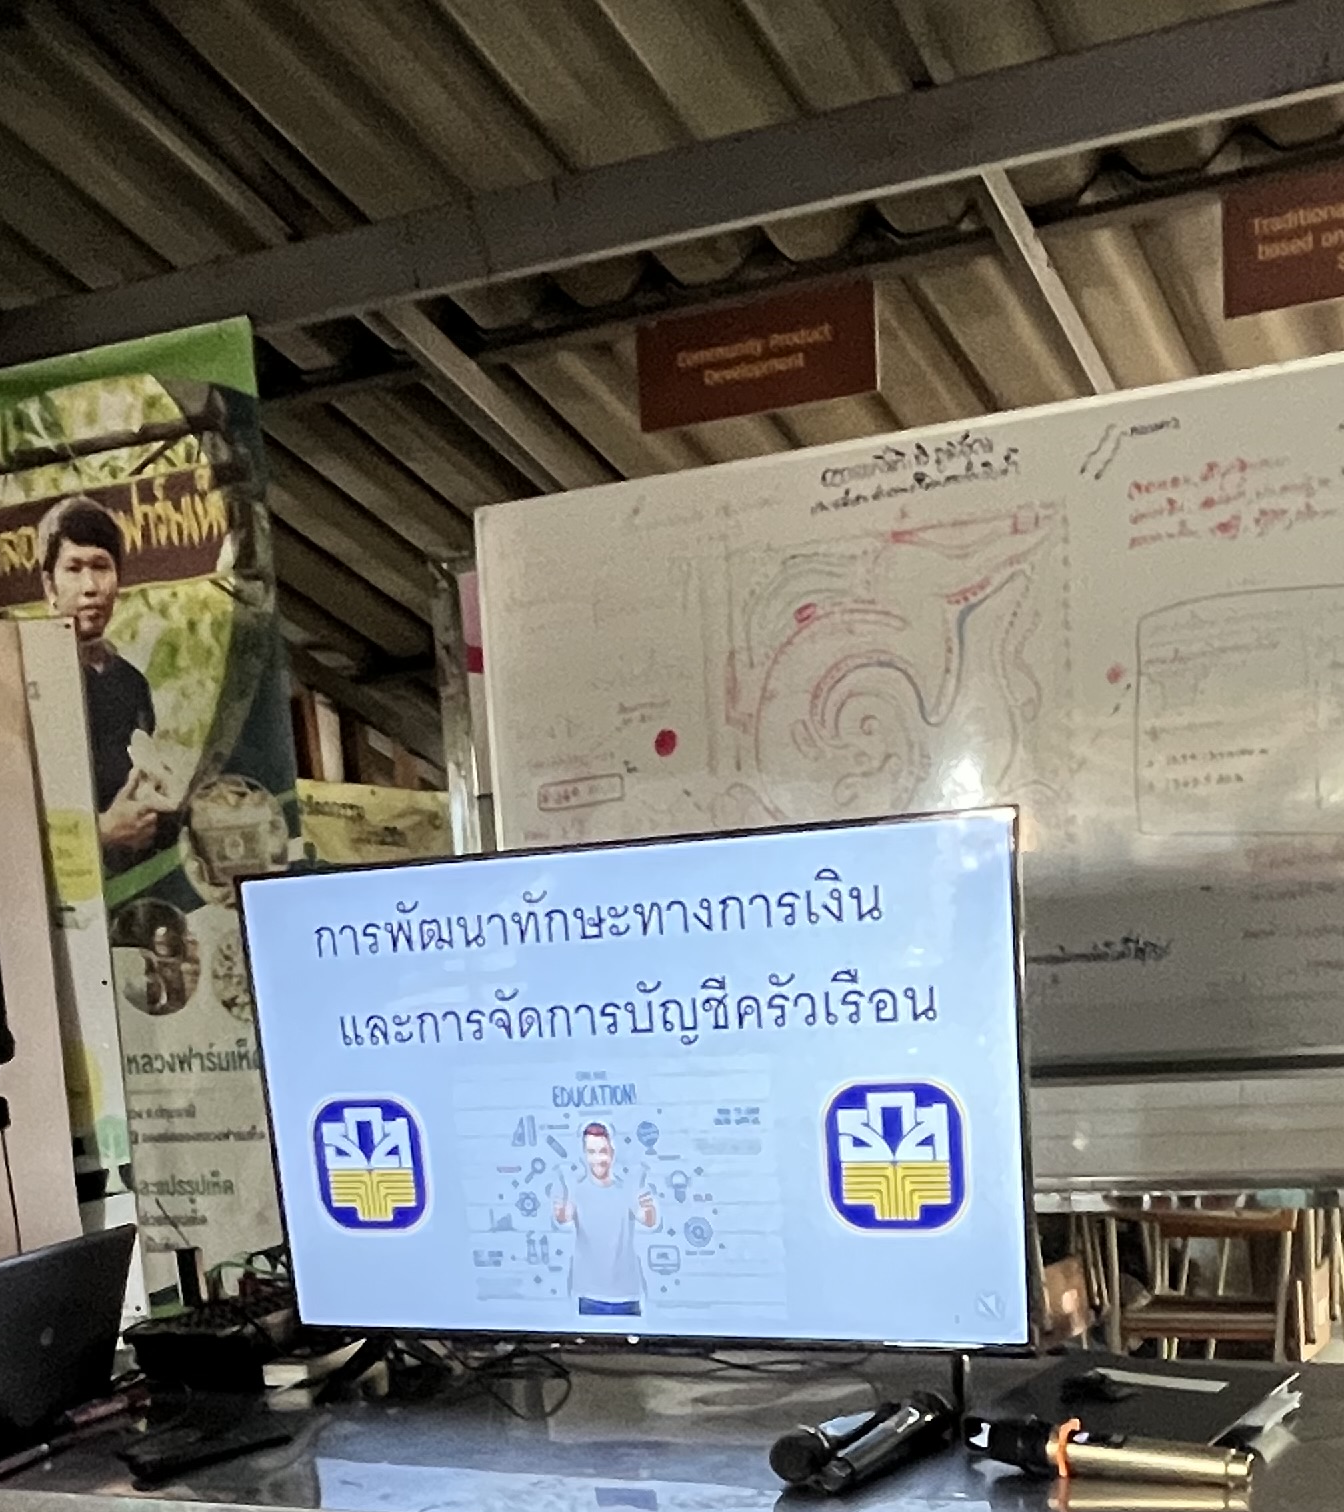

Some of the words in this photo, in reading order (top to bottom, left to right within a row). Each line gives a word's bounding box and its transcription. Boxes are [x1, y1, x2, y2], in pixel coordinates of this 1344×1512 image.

[1257, 232, 1314, 261] based
[314, 868, 883, 958] การพัฒนาทักษะทางการเงิน
[340, 968, 938, 1047] และการจัดการบัญชีครัวเรือน
